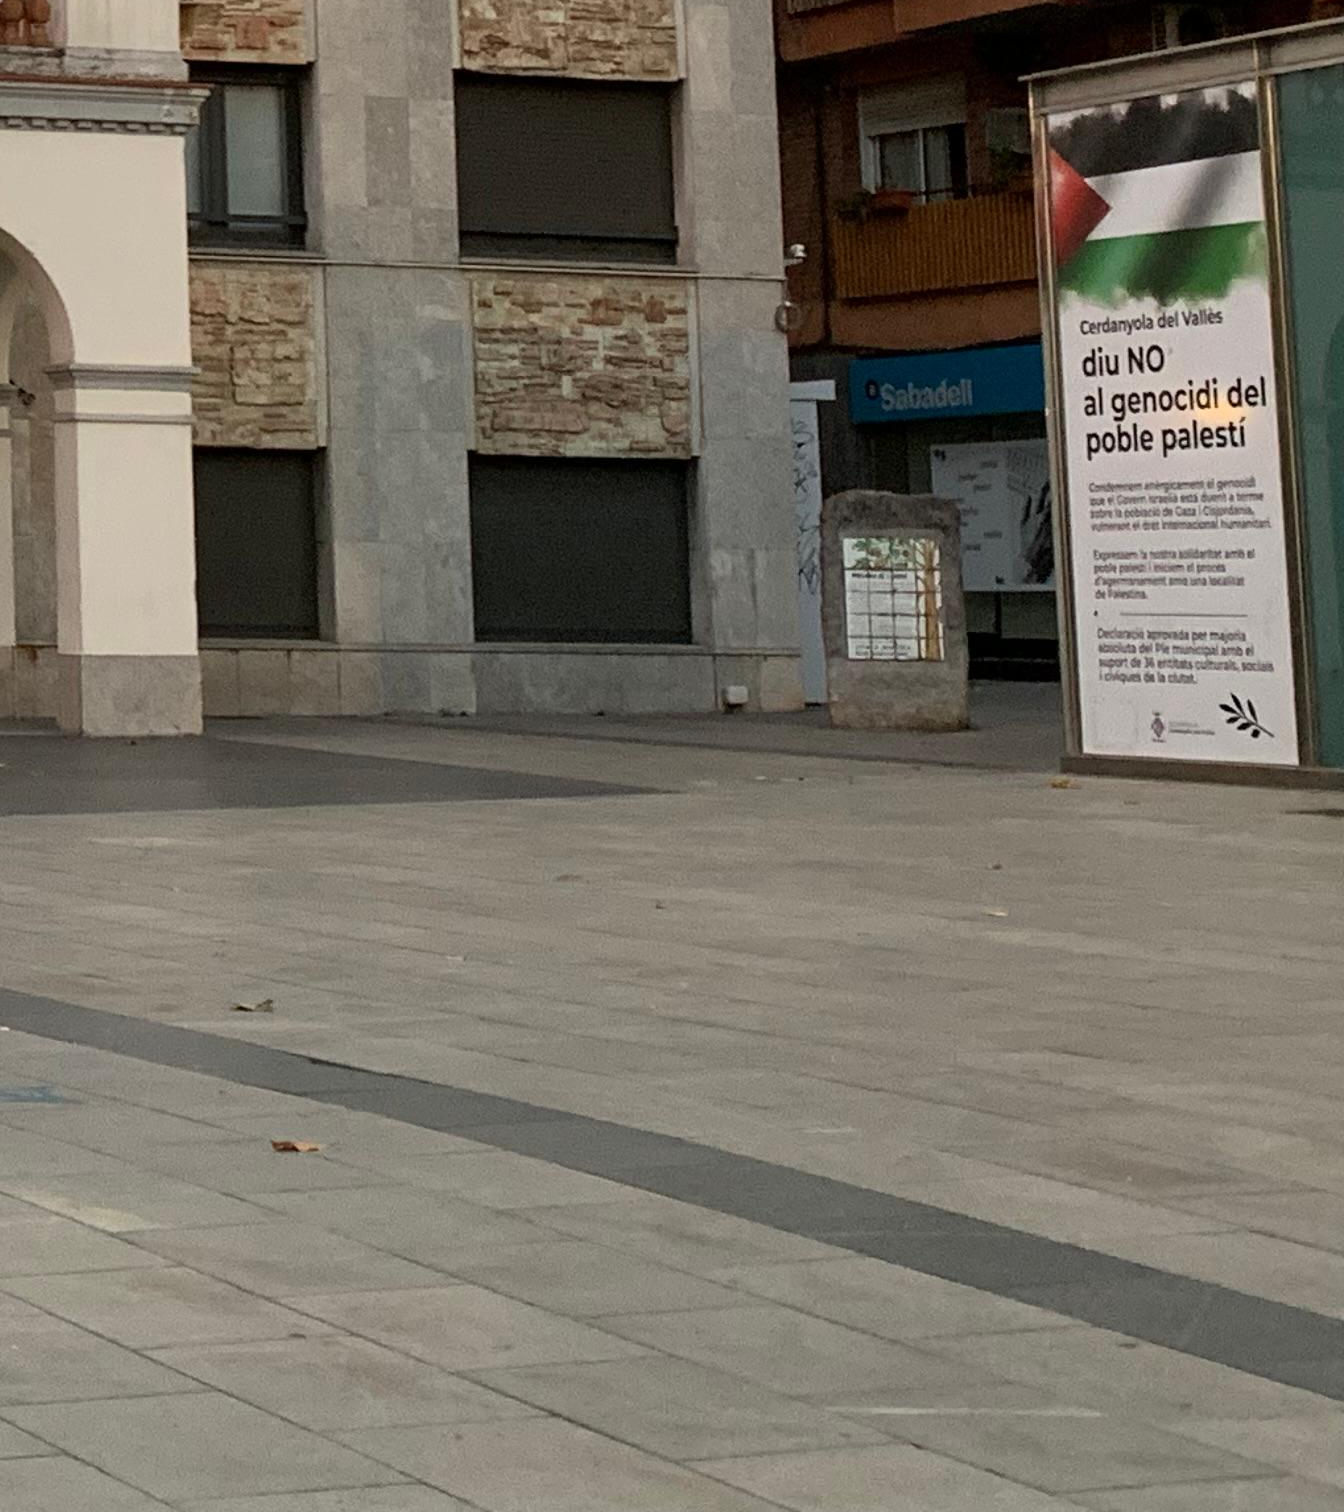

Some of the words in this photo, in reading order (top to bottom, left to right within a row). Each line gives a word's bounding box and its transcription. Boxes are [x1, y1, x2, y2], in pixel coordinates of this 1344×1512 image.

[1080, 314, 1153, 335] Cerdanyola
[1157, 312, 1179, 328] del
[1181, 308, 1223, 326] Vallès
[1082, 347, 1119, 377] diu
[1127, 344, 1165, 374] NO
[880, 379, 973, 412] Sabadell
[1084, 387, 1104, 417] al
[1112, 377, 1218, 422] genocidi
[1227, 376, 1267, 408] del
[1086, 423, 1153, 461] poble
[1161, 417, 1246, 458] palestí
